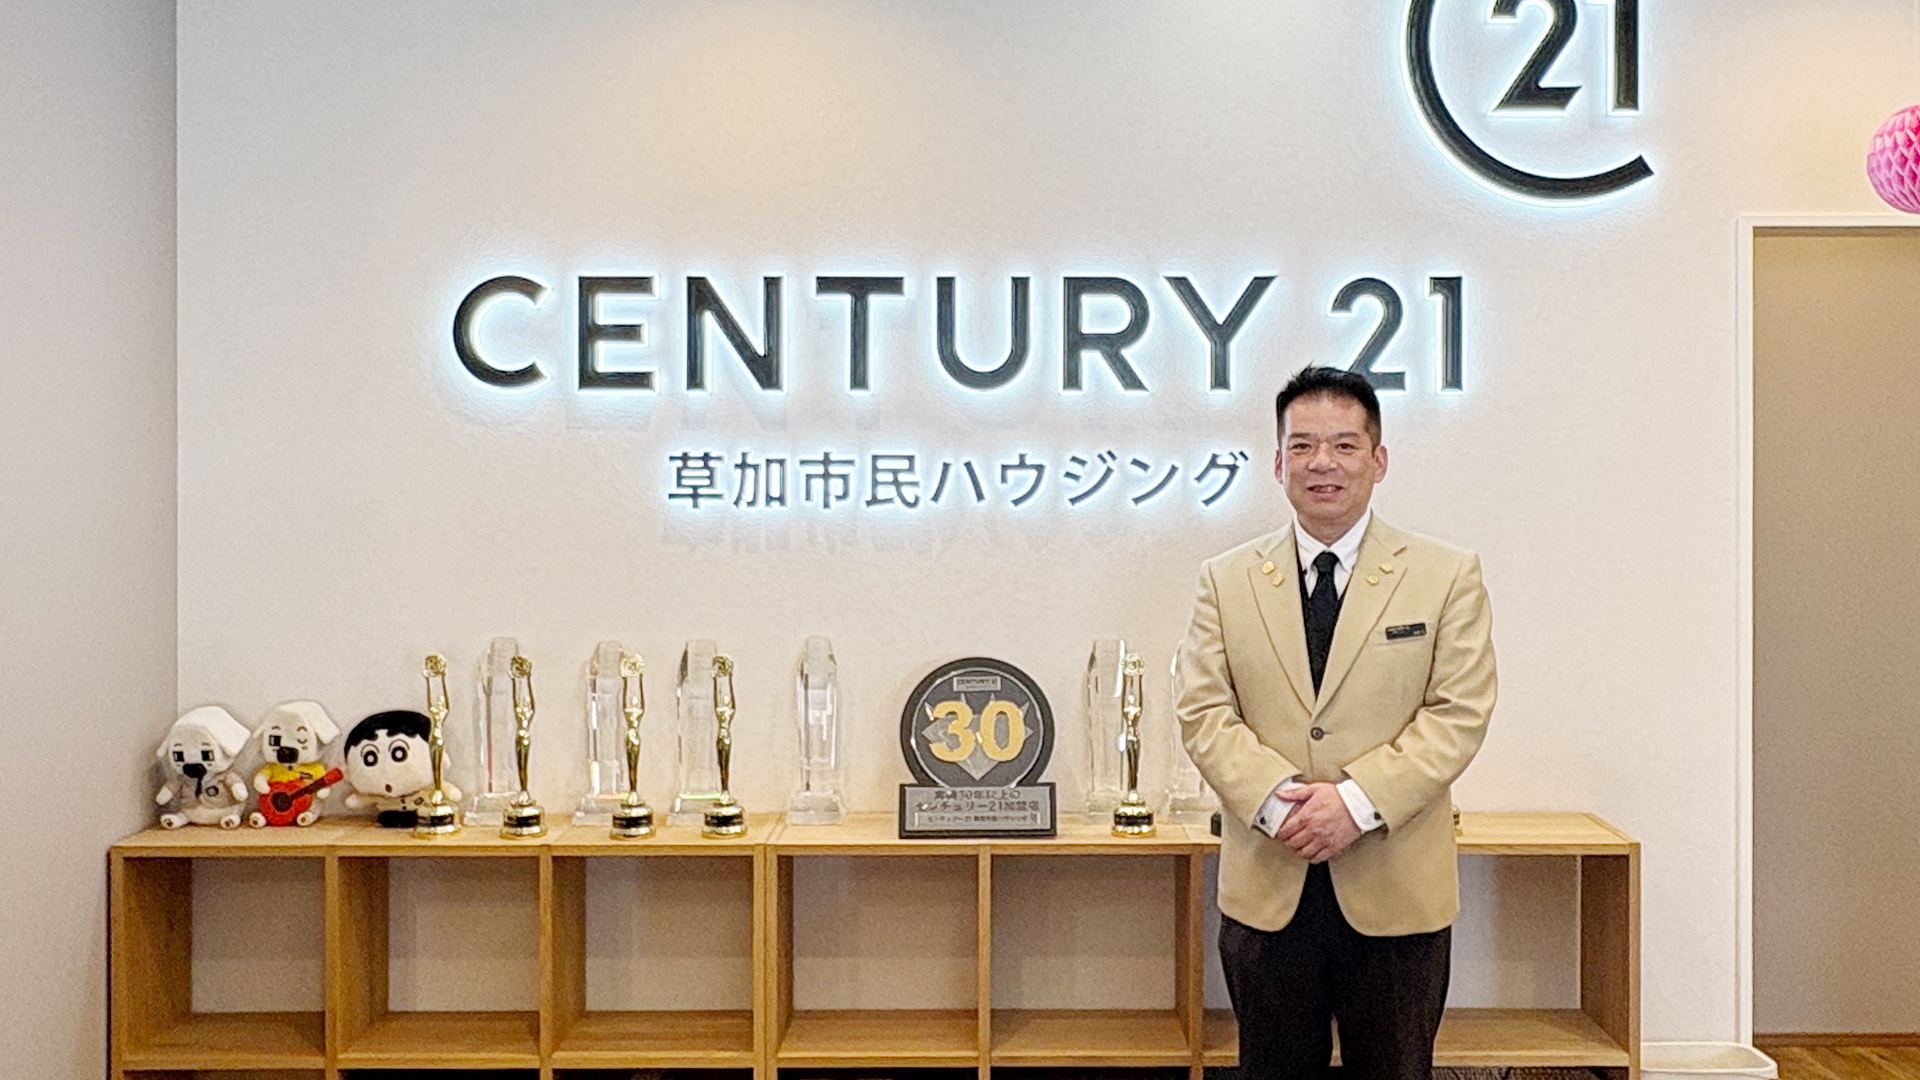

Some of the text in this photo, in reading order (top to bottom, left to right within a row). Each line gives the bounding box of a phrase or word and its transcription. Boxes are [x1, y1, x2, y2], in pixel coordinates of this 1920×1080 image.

[1490, 0, 1639, 111] 21
[453, 275, 1463, 392] CENTURY 21
[668, 449, 1249, 509] 草加市民ハウジング
[929, 700, 1025, 763] 30
